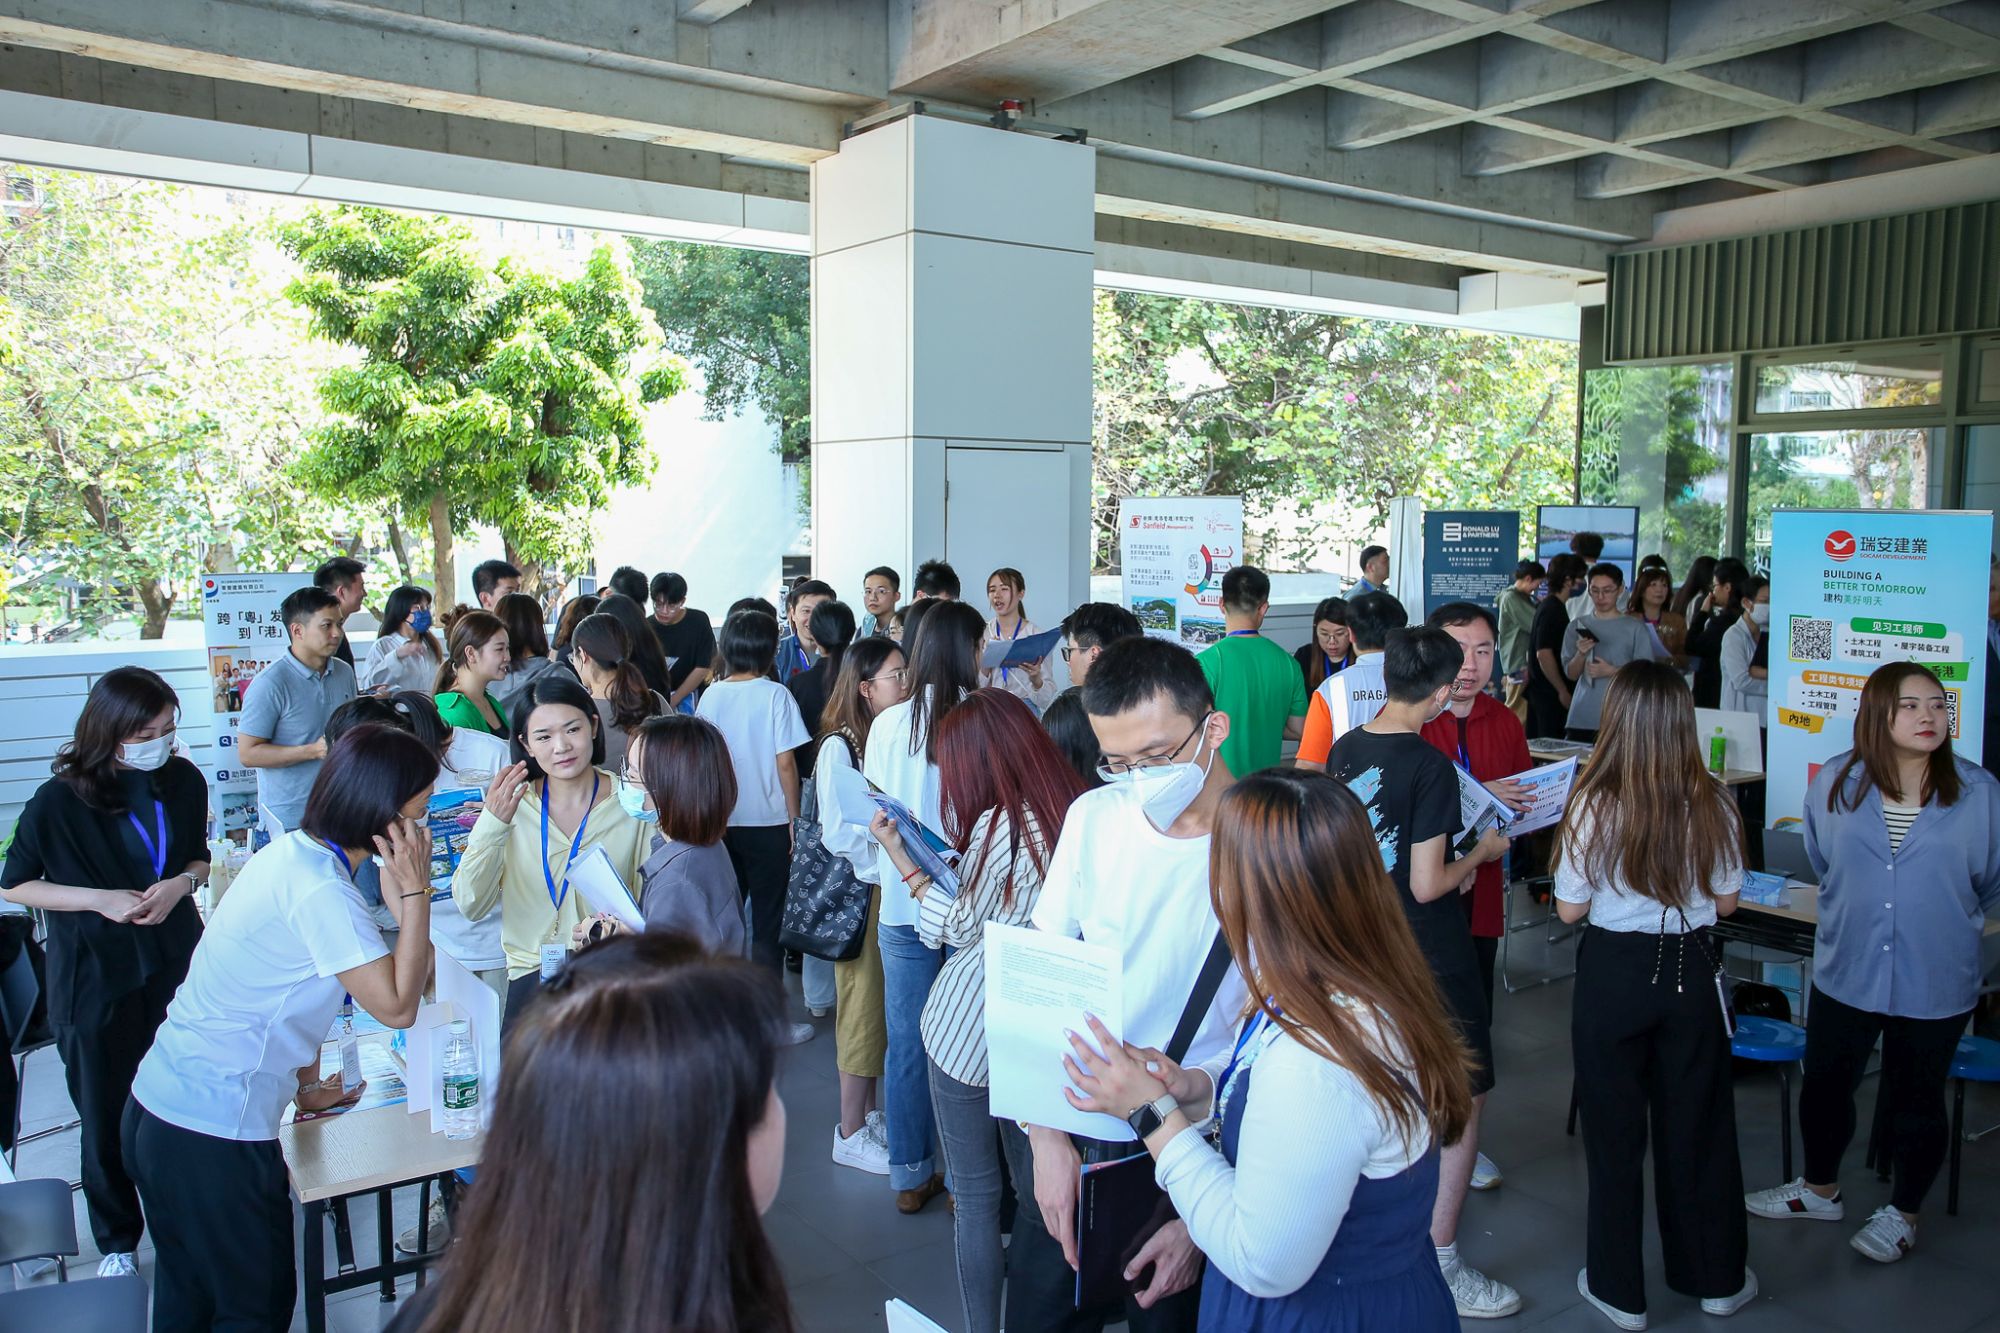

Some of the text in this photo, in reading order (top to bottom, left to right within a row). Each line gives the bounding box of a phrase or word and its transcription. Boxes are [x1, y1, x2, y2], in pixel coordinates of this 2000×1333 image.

[1860, 536, 1928, 554] 瑞安建業
[1823, 569, 1882, 580] BUILDING A
[1823, 581, 1927, 595] BETTER TOMORROW
[1823, 593, 1883, 606] 建构美好明天
[238, 626, 283, 640] 到「港」
[1872, 621, 1925, 635] 见习工程师
[1850, 638, 1882, 648] 土木工程
[1900, 641, 1950, 654] 屋宇装备工程
[1850, 649, 1881, 659] 建筑工程
[1931, 665, 1955, 678] 香港
[1807, 690, 1838, 700] 土木工程
[1807, 701, 1838, 711] 工程管理
